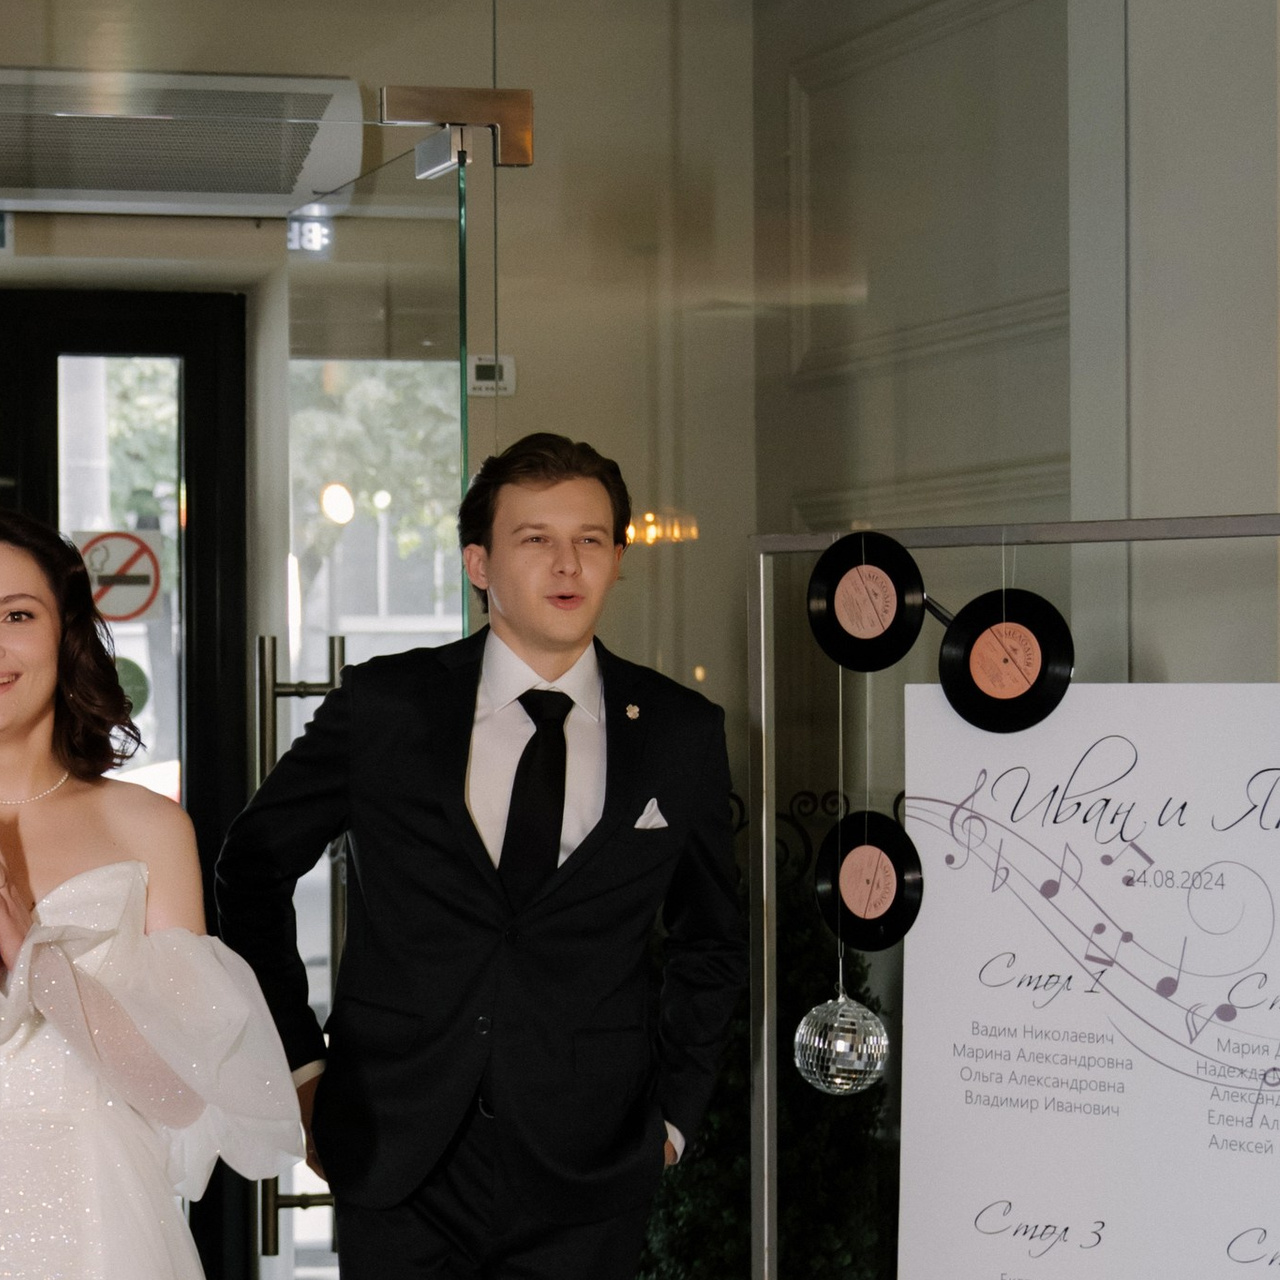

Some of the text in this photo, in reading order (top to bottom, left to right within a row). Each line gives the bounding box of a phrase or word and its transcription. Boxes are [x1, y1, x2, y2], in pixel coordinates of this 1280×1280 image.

[991, 735, 1146, 844] Иван
[1157, 797, 1188, 827] и
[1126, 868, 1225, 890] 24.08.2024
[978, 951, 1108, 1009] Стол 1
[970, 1020, 1114, 1044] Вадим Николаевич
[952, 1043, 1133, 1071] Марина Александровна
[1216, 1037, 1269, 1059] Мария
[959, 1066, 1125, 1094] Ольга Александровна
[1196, 1060, 1266, 1082] Надежда
[964, 1089, 1120, 1117] Владимир Иванович
[1207, 1108, 1253, 1128] Елена
[1208, 1134, 1274, 1155] Алексей
[974, 1200, 1106, 1258] Стол 3
